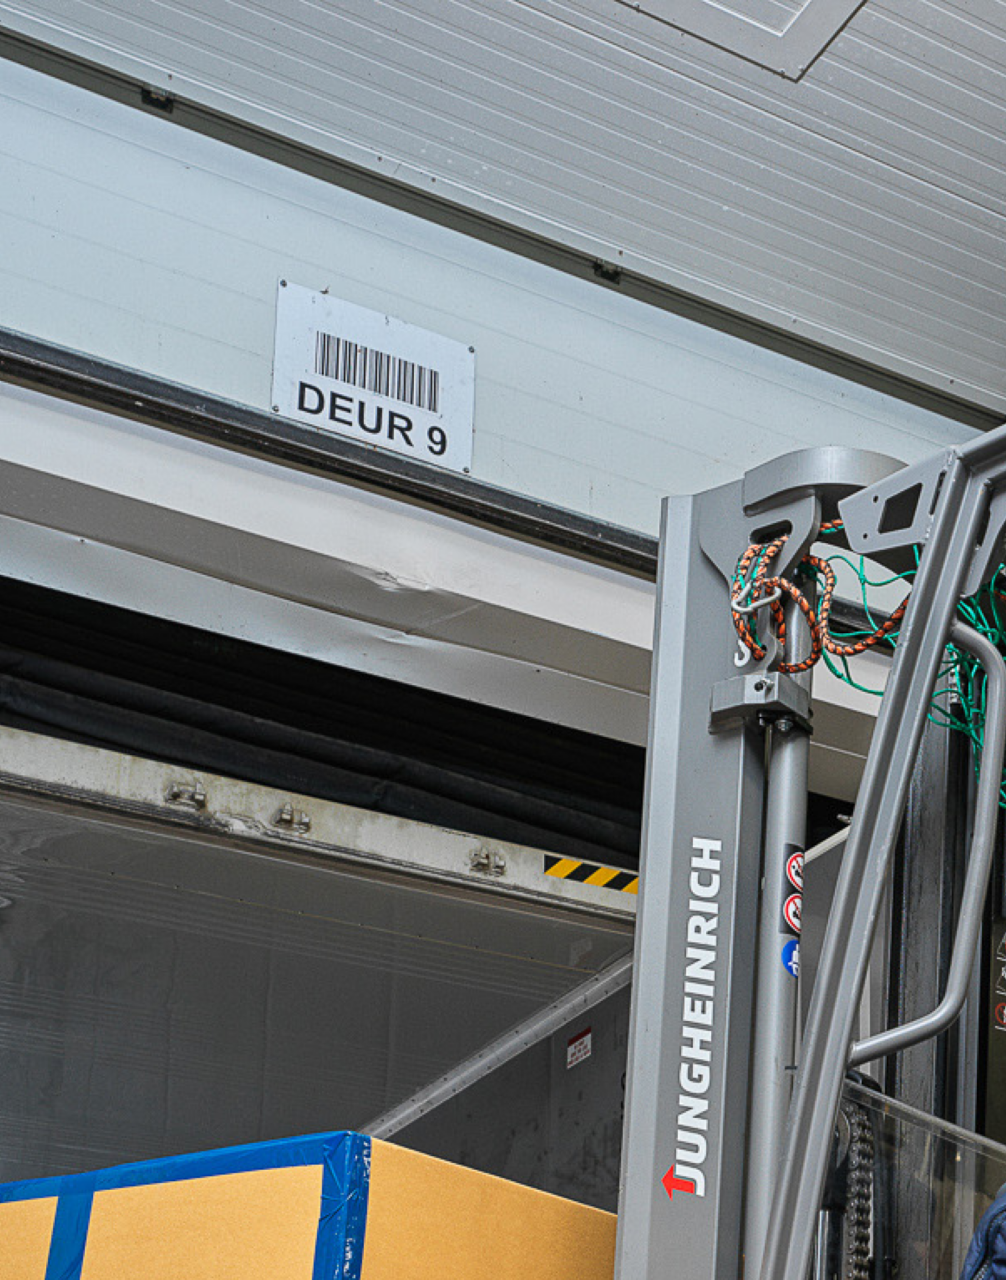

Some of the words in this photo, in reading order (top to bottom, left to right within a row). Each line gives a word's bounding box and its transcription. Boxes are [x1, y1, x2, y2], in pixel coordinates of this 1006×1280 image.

[297, 380, 414, 448] DEUR
[426, 425, 447, 456] 9
[668, 836, 723, 1199] JUNGHEINRICH
